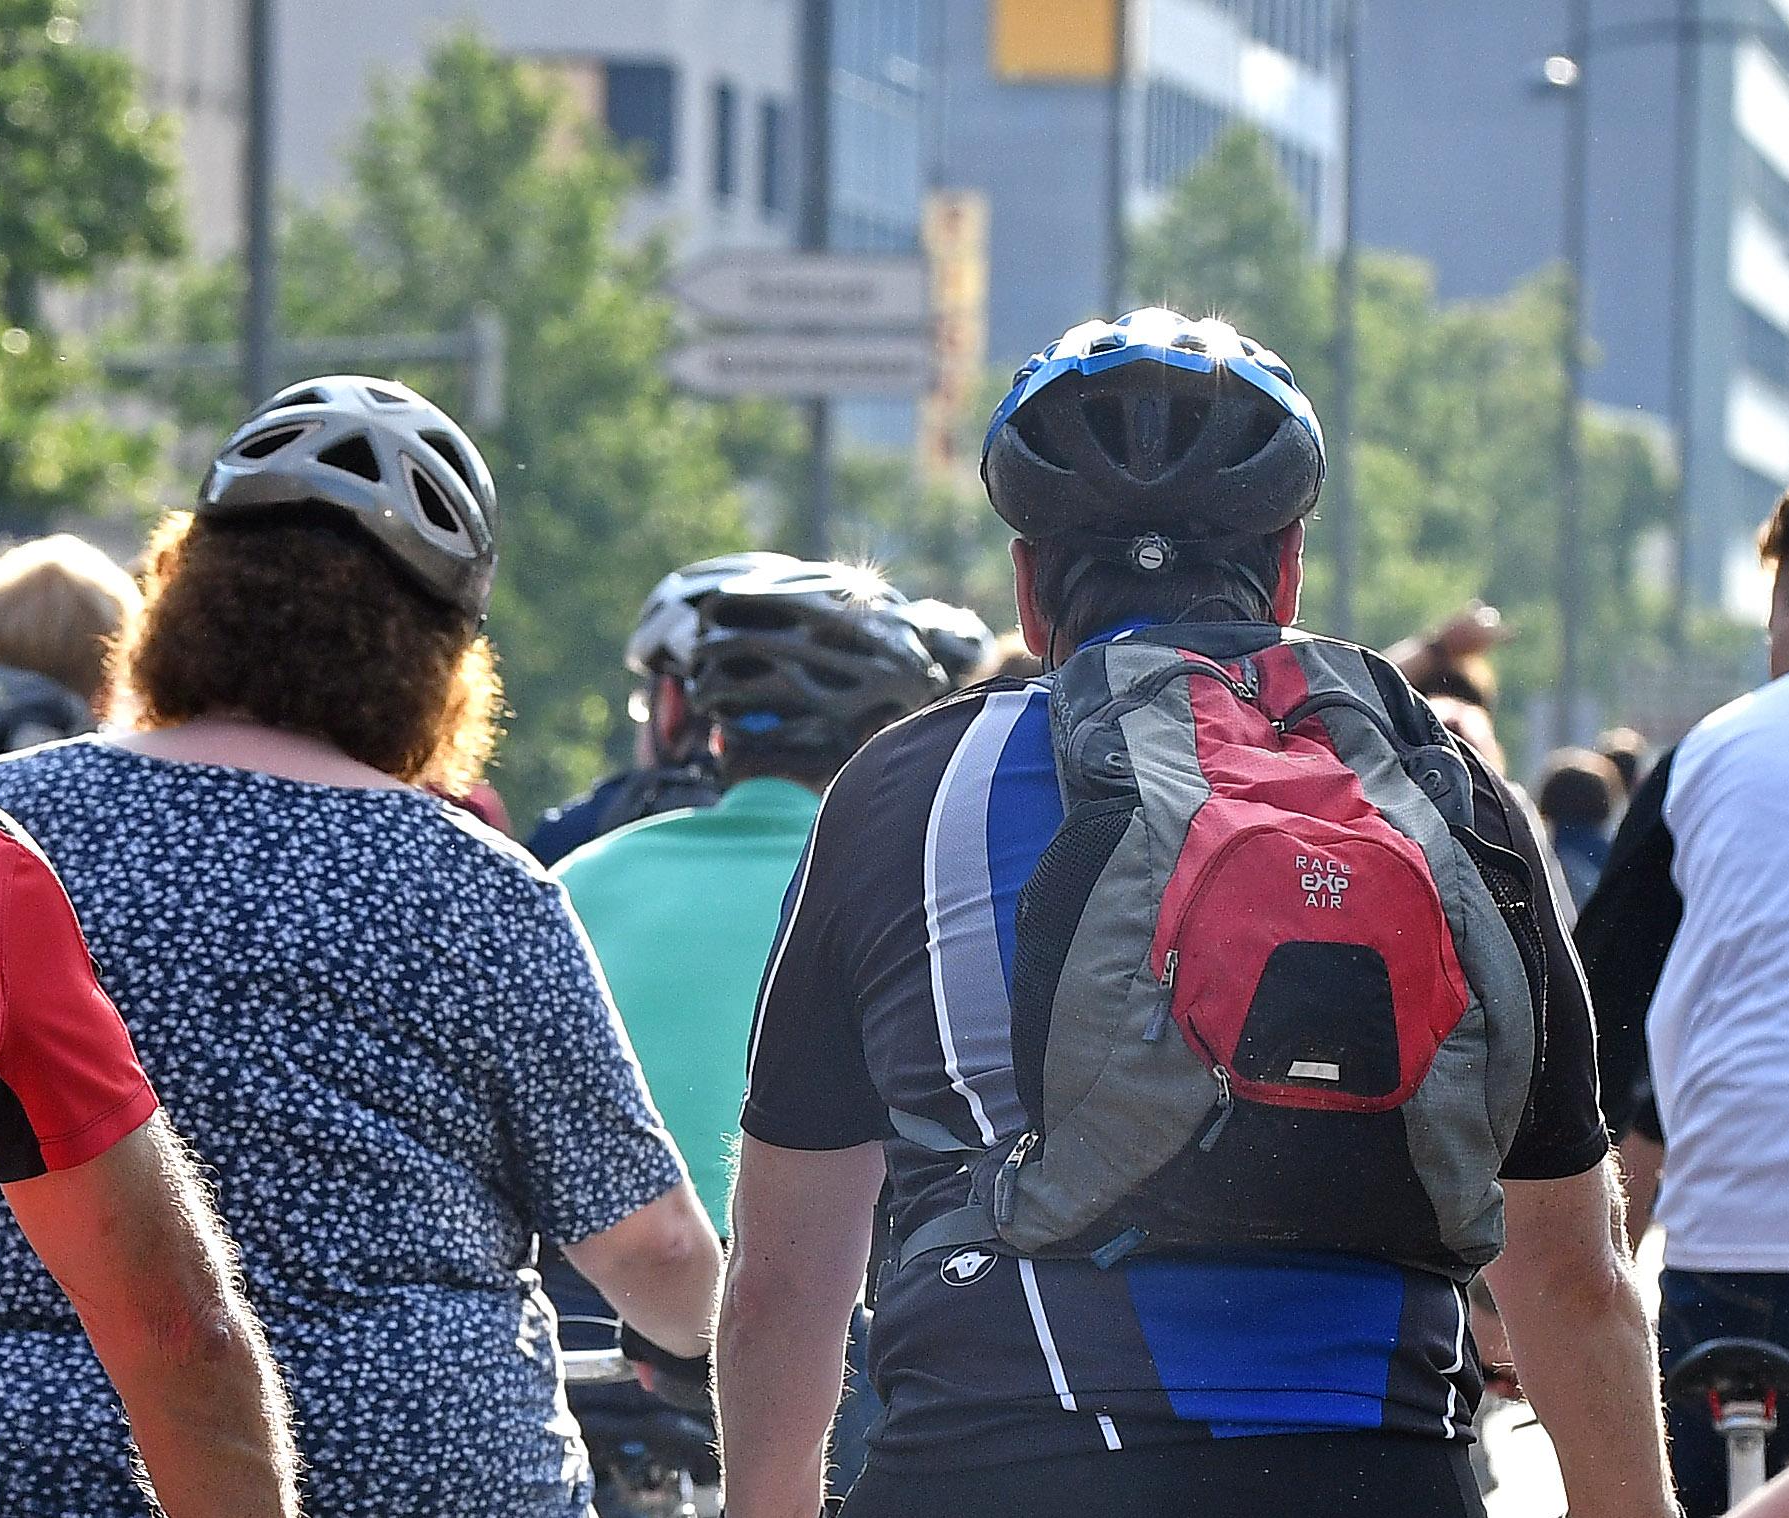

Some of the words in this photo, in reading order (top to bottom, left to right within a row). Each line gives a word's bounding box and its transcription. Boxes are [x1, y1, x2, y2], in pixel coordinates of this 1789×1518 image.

[1296, 855, 1351, 874] RACE
[1301, 872, 1349, 893] EXP
[1305, 893, 1342, 909] AIR
